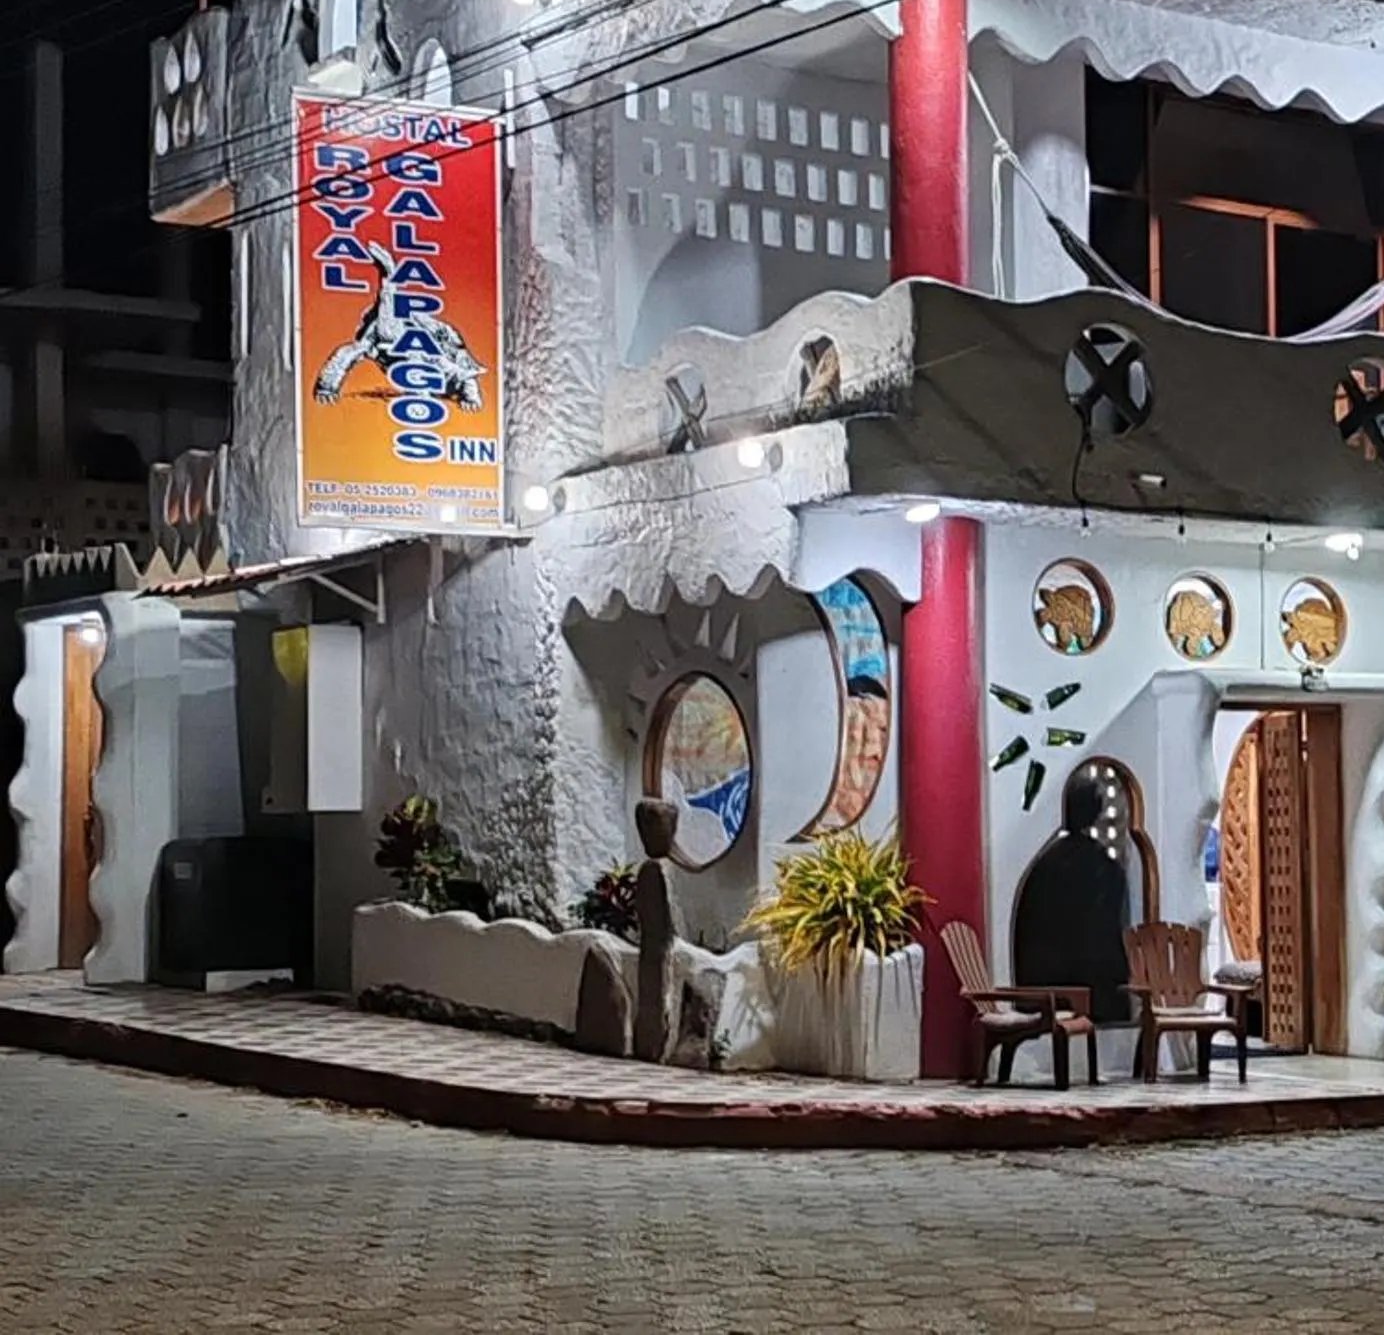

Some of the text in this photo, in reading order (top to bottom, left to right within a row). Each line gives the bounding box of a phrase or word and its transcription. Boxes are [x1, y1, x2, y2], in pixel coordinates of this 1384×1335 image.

[323, 106, 472, 147] HOSTAL
[312, 144, 373, 291] ROYAL
[385, 152, 447, 461] GALAPAGOS
[449, 437, 497, 464] INN
